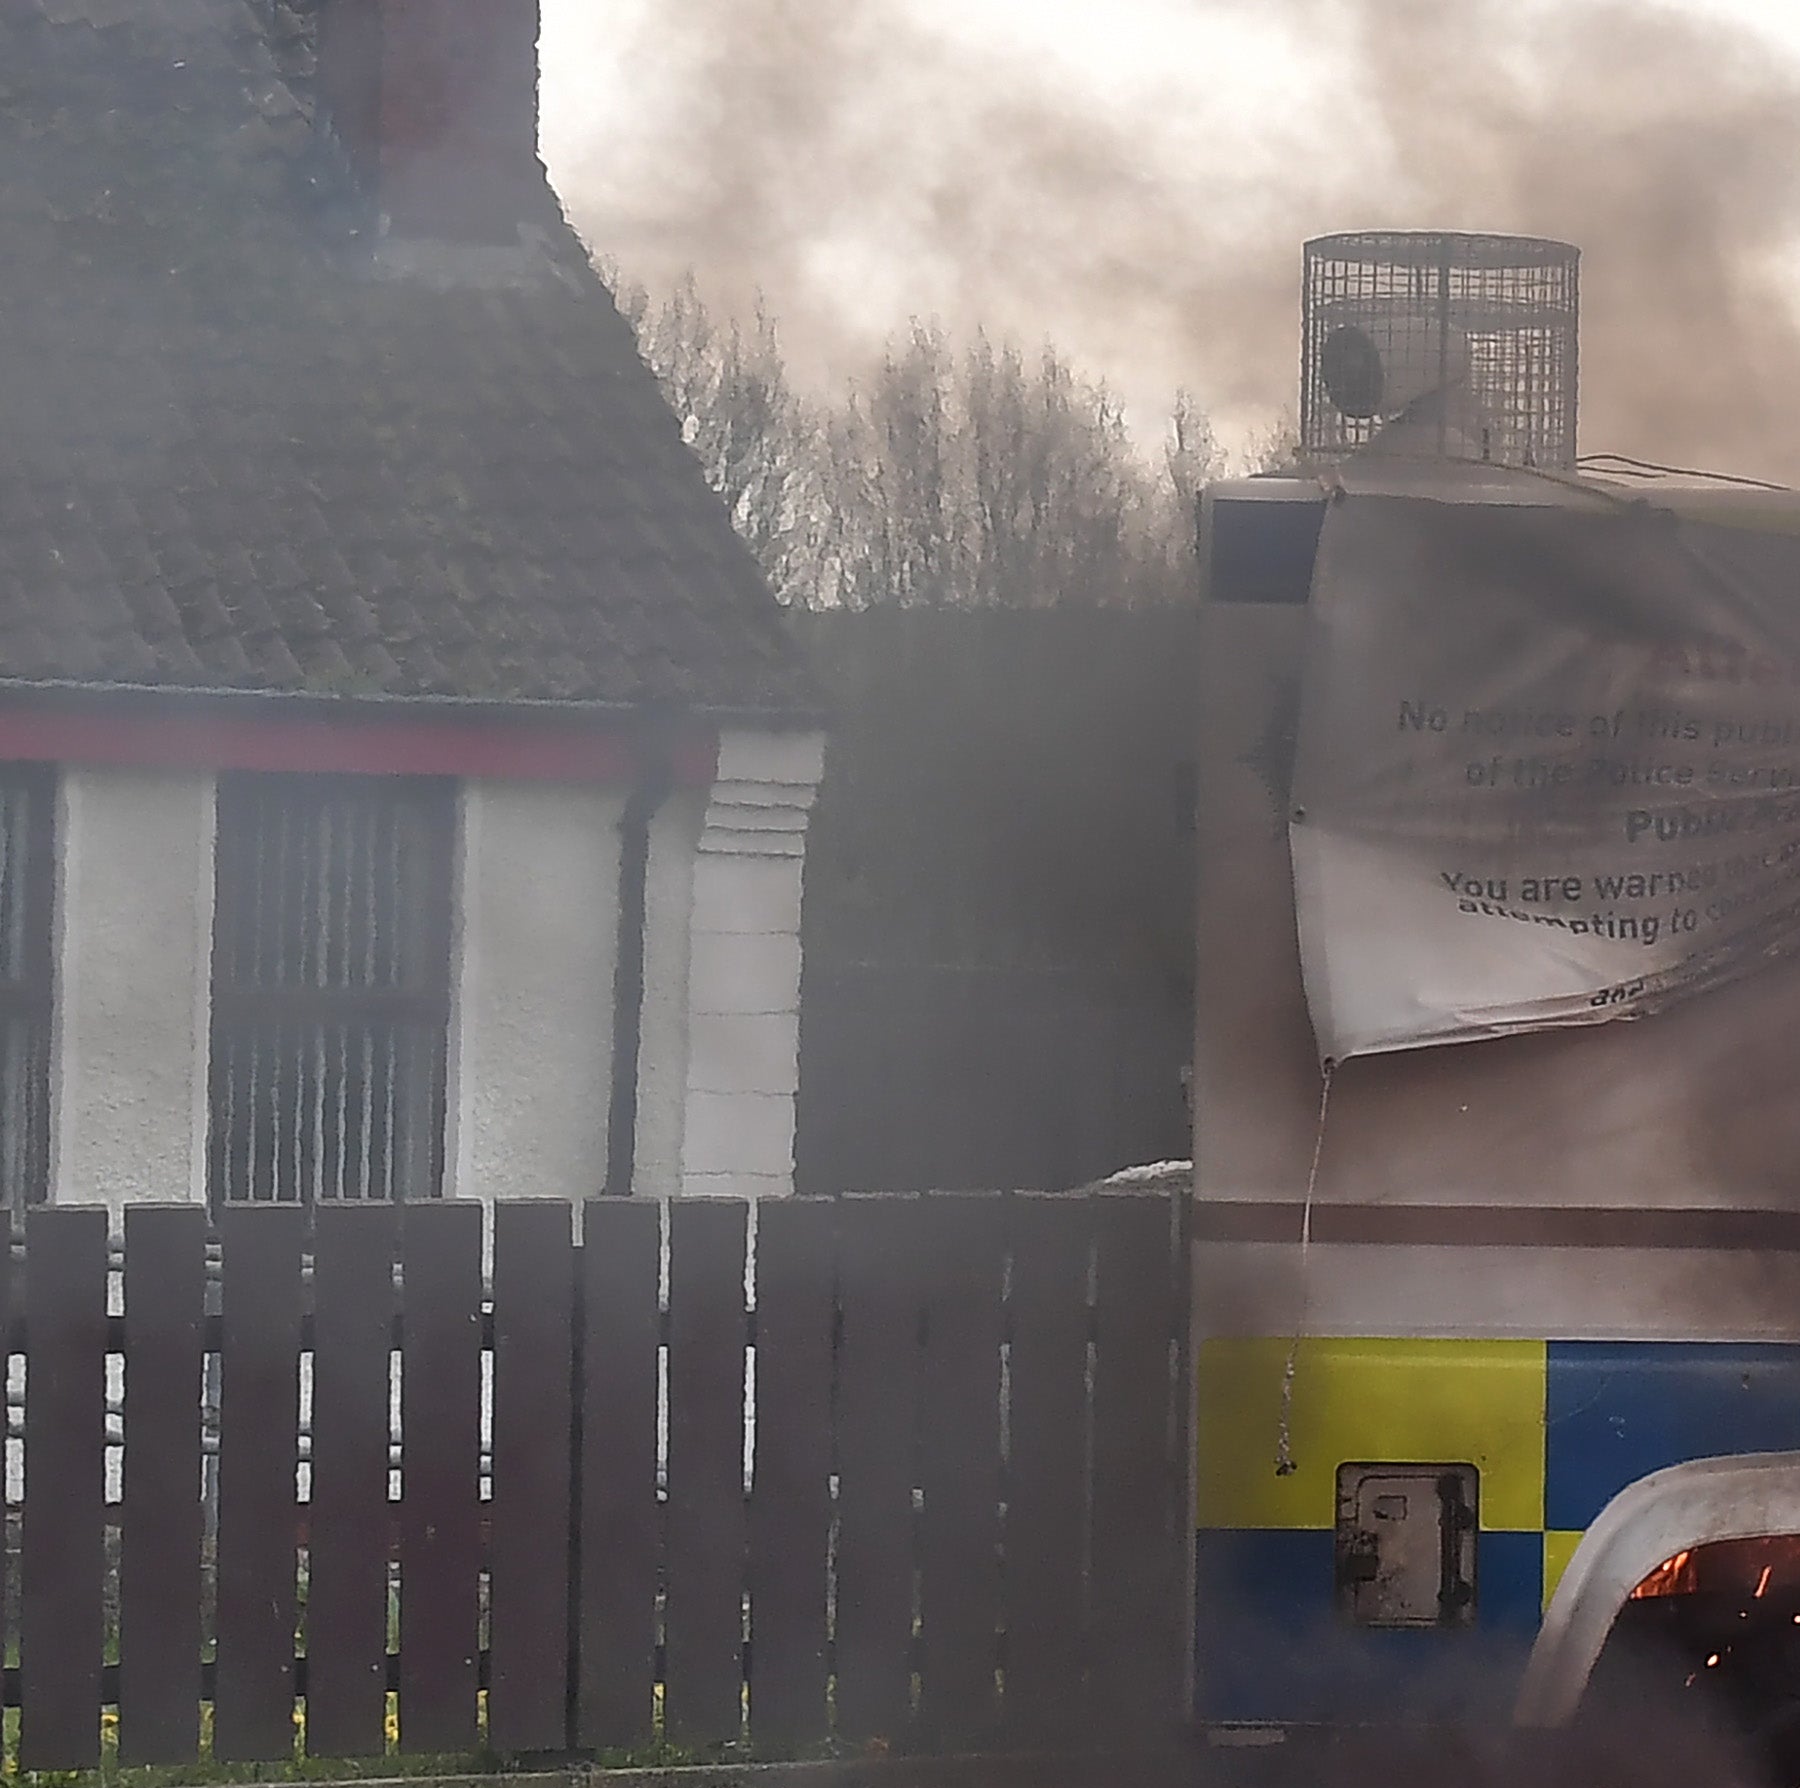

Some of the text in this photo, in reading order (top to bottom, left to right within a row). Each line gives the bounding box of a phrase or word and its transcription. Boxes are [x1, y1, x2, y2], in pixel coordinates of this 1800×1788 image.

[1397, 696, 1450, 736] No
[1589, 709, 1627, 742] of
[1636, 706, 1701, 742] this
[1466, 755, 1504, 787] of
[1513, 757, 1575, 788] the
[1440, 872, 1508, 902] You
[1520, 875, 1583, 902] are
[1458, 897, 1661, 946] attempting
[1671, 908, 1698, 934] to
